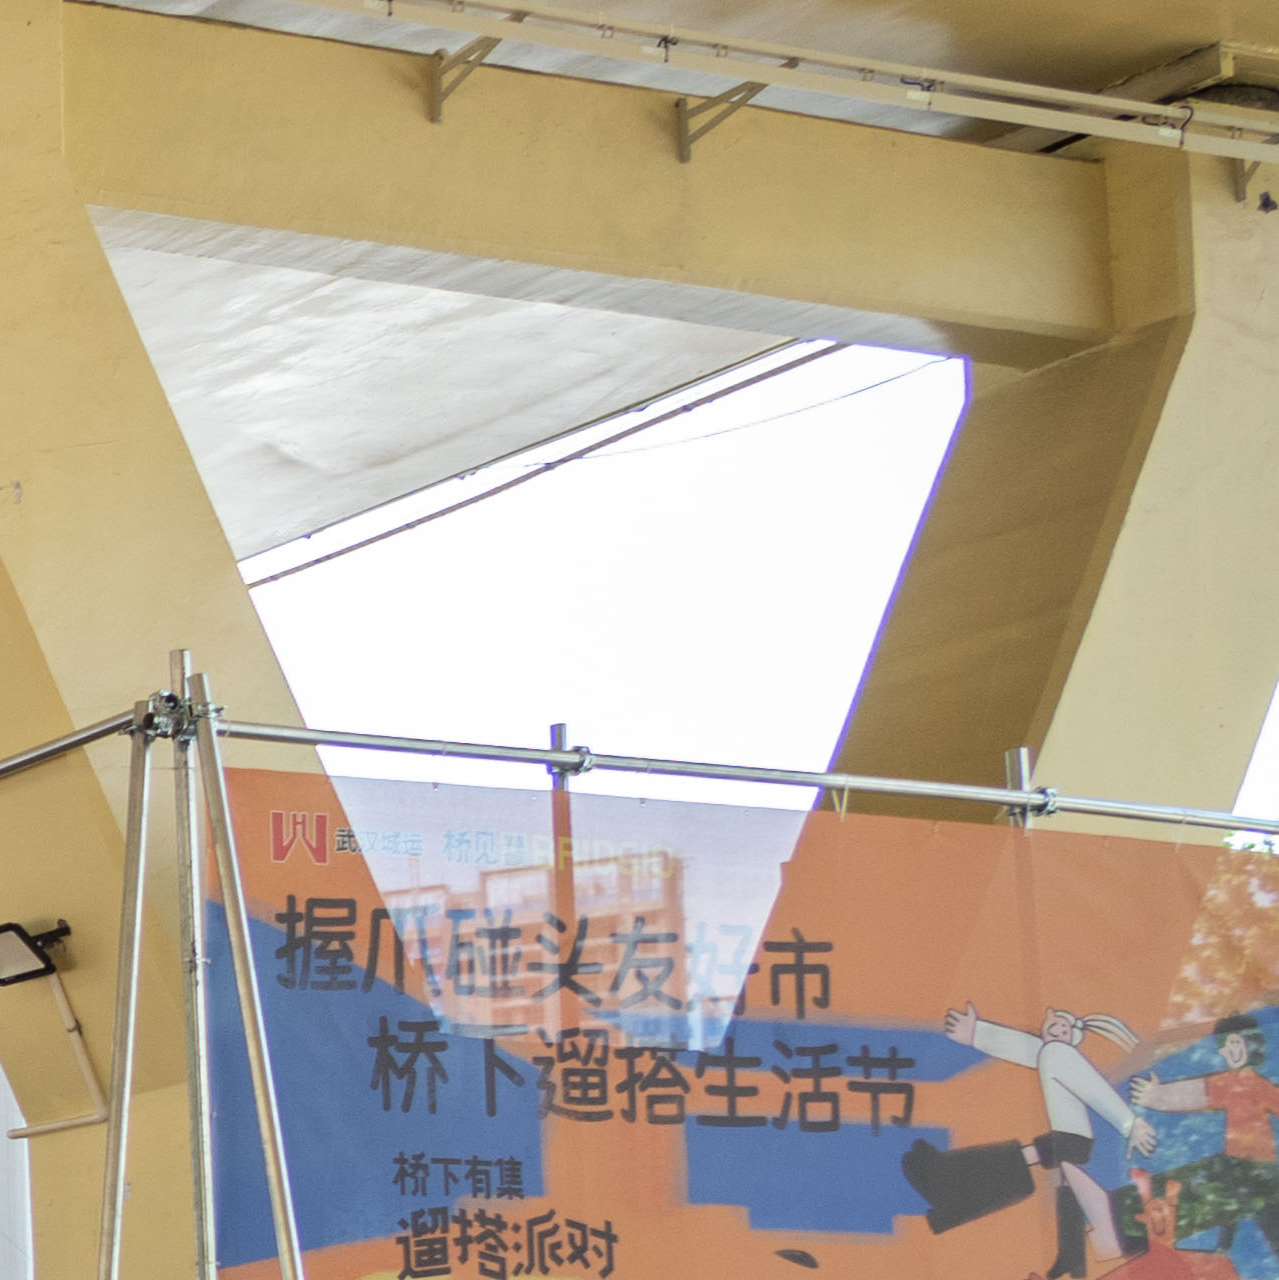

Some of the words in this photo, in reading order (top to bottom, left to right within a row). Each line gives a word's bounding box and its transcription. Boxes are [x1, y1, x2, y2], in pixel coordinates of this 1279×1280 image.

[368, 1014, 916, 1135] 桥下遛搭生活节
[393, 1151, 525, 1201] 桥下有集
